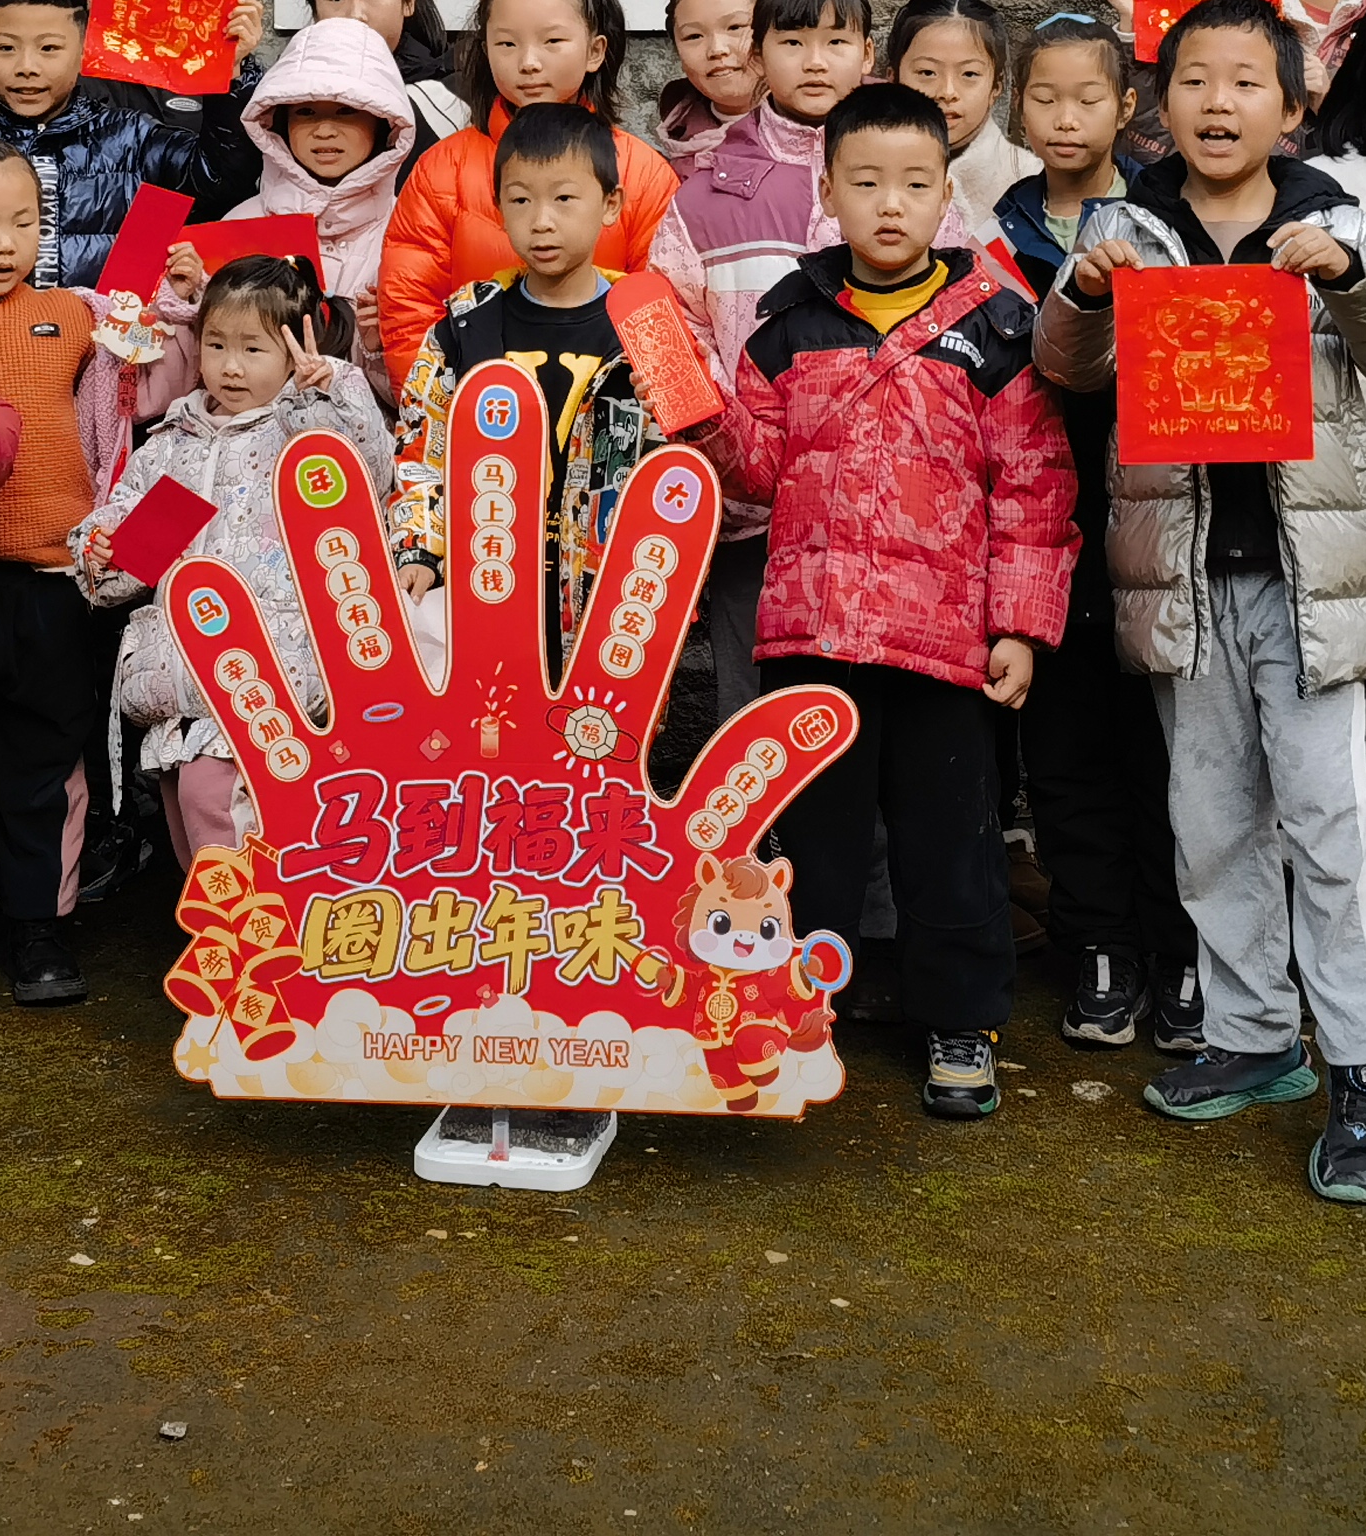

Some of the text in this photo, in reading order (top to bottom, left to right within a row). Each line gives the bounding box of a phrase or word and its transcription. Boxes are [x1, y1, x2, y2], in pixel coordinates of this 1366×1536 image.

[482, 396, 512, 428] 行
[1148, 416, 1202, 437] HAPPY
[1205, 416, 1239, 434] NEW
[662, 479, 690, 510] 大
[479, 462, 506, 593] 马上有钱
[193, 595, 223, 624] 马
[324, 535, 383, 662] 马上有福
[609, 542, 668, 670] 马踏宏图
[222, 657, 302, 770] 幸福加马
[580, 723, 601, 745] 福
[280, 770, 673, 888] 马到福来
[207, 869, 233, 896] 恭
[248, 915, 275, 944] 贺
[300, 884, 675, 998] 圈出年味
[200, 948, 229, 978] 新
[240, 993, 266, 1022] 春
[364, 1032, 630, 1068] HAPPY NEW YEAR
